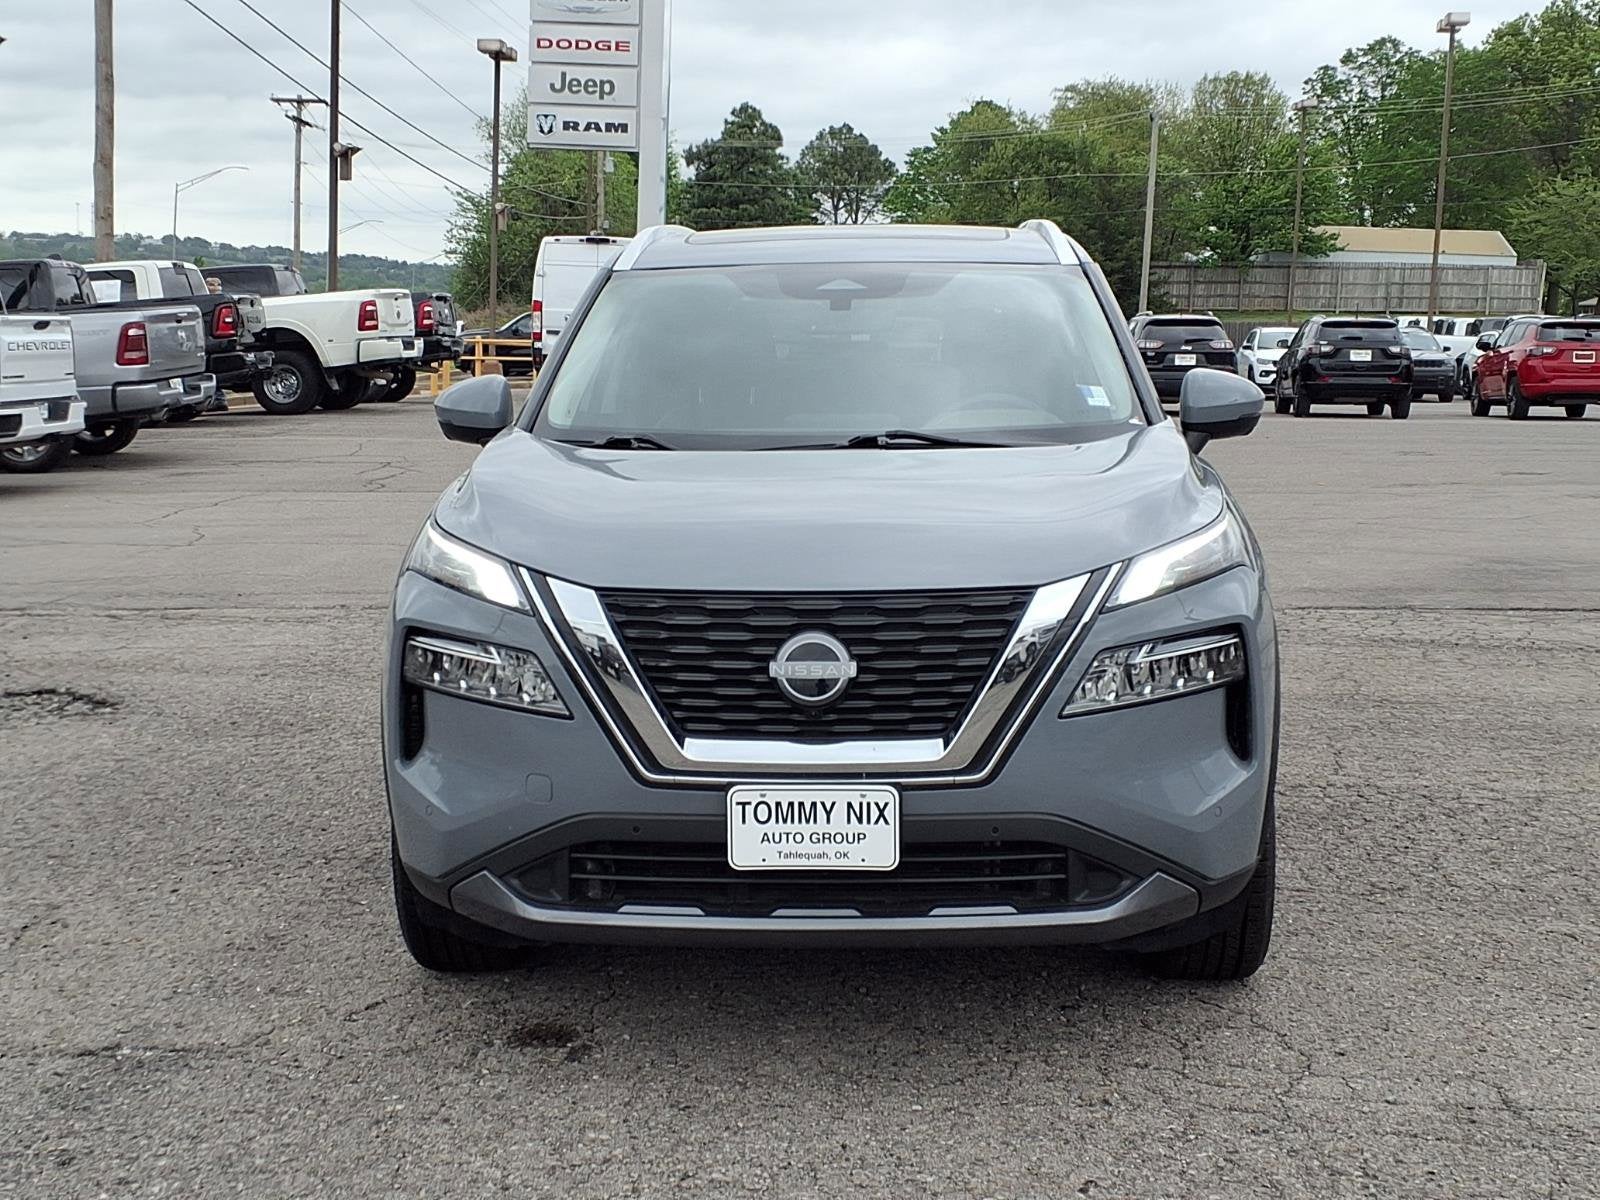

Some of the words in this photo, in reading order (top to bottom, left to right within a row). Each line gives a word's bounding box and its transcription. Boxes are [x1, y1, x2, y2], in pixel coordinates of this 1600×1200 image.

[536, 38, 631, 52] DODGE
[550, 71, 616, 100] Jeep
[562, 120, 629, 134] RAM
[7, 341, 72, 351] CHEVROLET
[772, 665, 854, 676] NISSAN
[735, 800, 837, 826] TOMMY
[846, 800, 891, 826] NIX
[760, 831, 805, 845] AUTO
[809, 831, 867, 845] GROUP
[777, 850, 832, 861] Tahlequah,
[834, 850, 850, 860] OK
